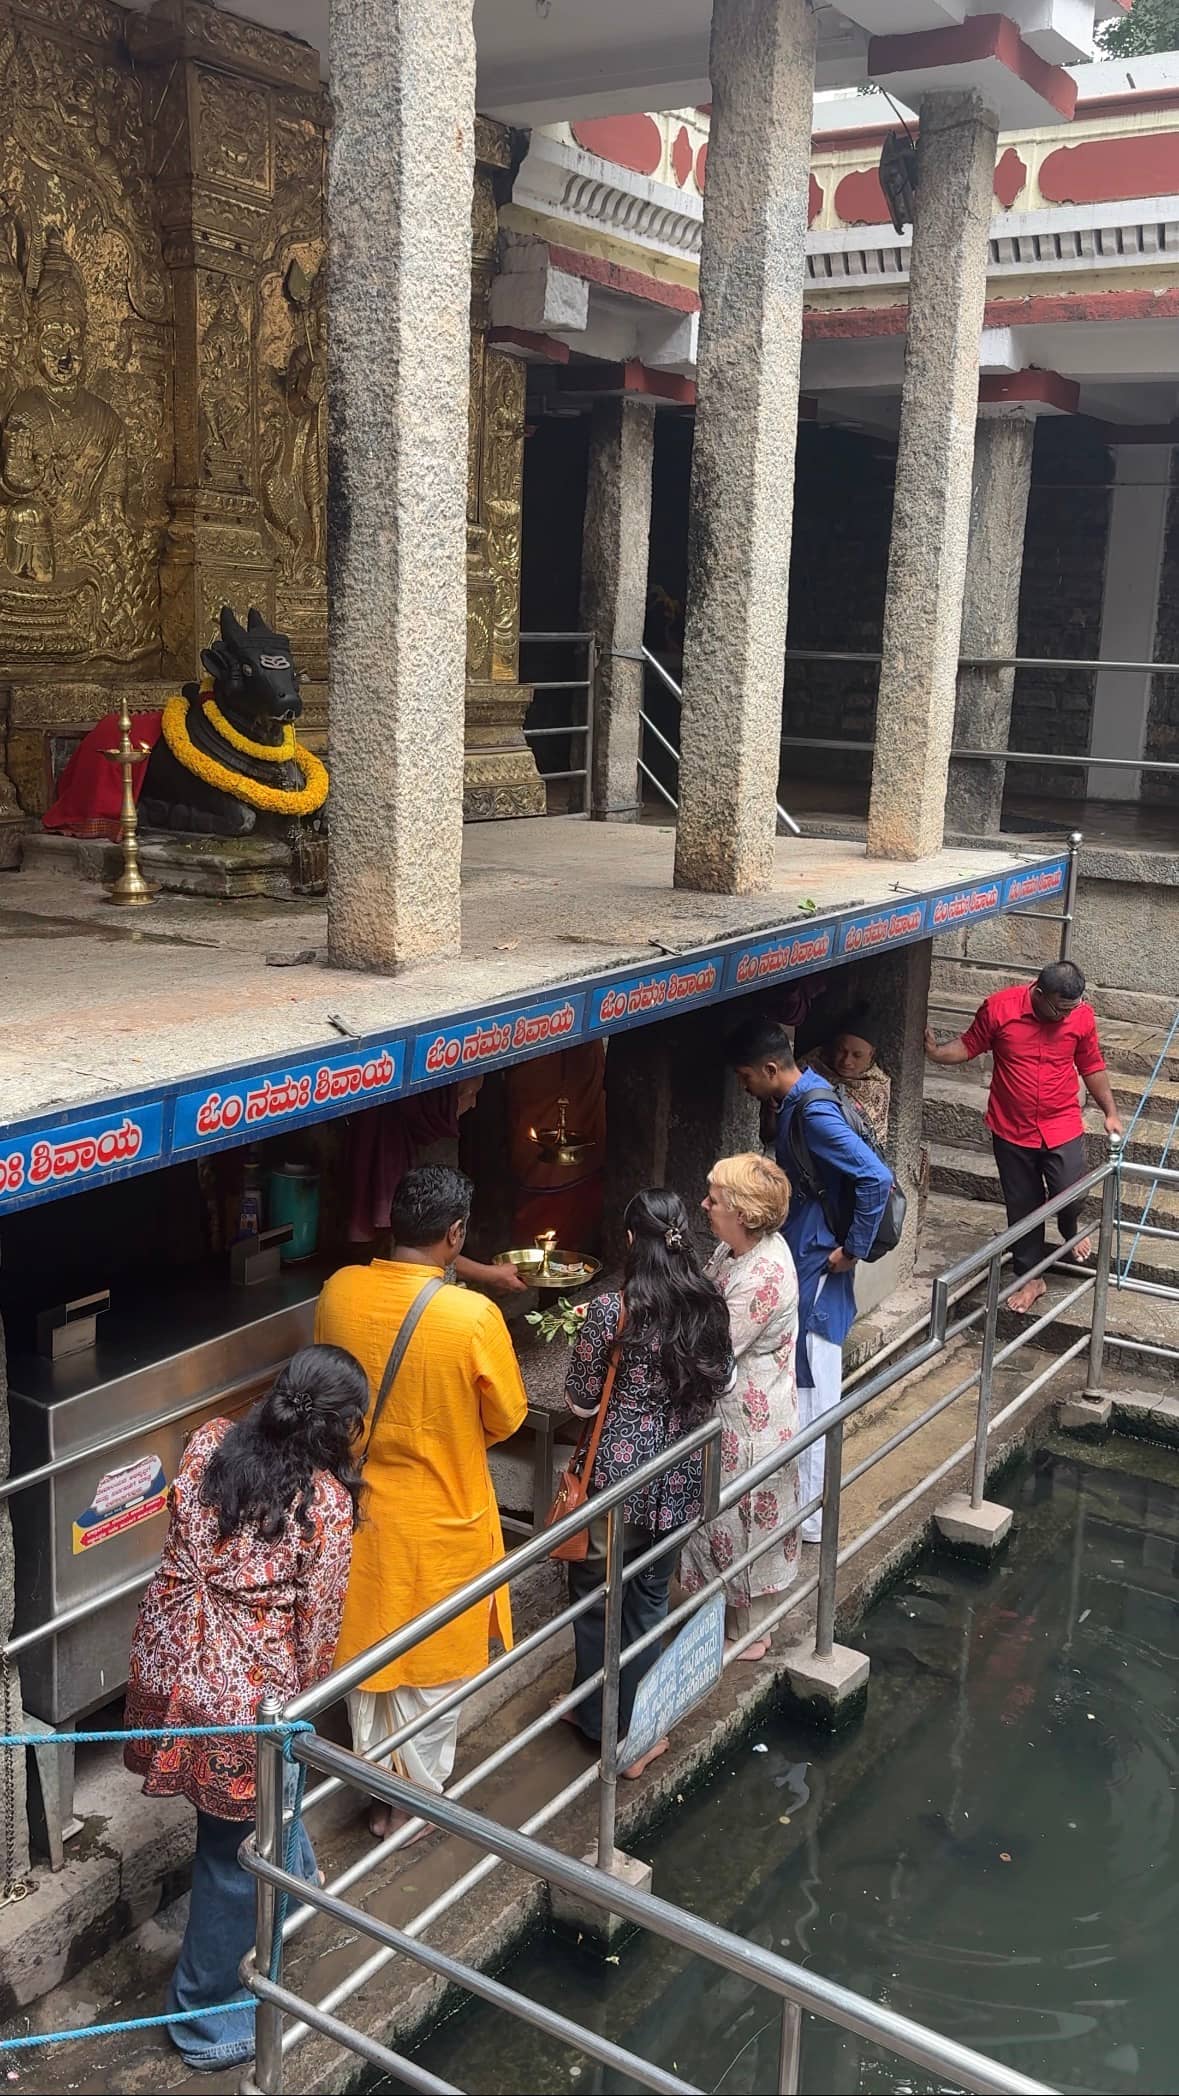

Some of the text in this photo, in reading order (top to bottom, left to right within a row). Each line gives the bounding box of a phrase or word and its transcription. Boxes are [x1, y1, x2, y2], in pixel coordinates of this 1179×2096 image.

[600, 964, 716, 1020] ಓಂ ನಮಃ ಶಿವಾಯ
[427, 1004, 574, 1071] ಓಂ ನಮಃ ಶಿವಾಯ
[198, 1052, 394, 1134] ಓಂ ನಮಃ ಶಿವಾಯ
[30, 1120, 140, 1182] ಶಿವಾಯ
